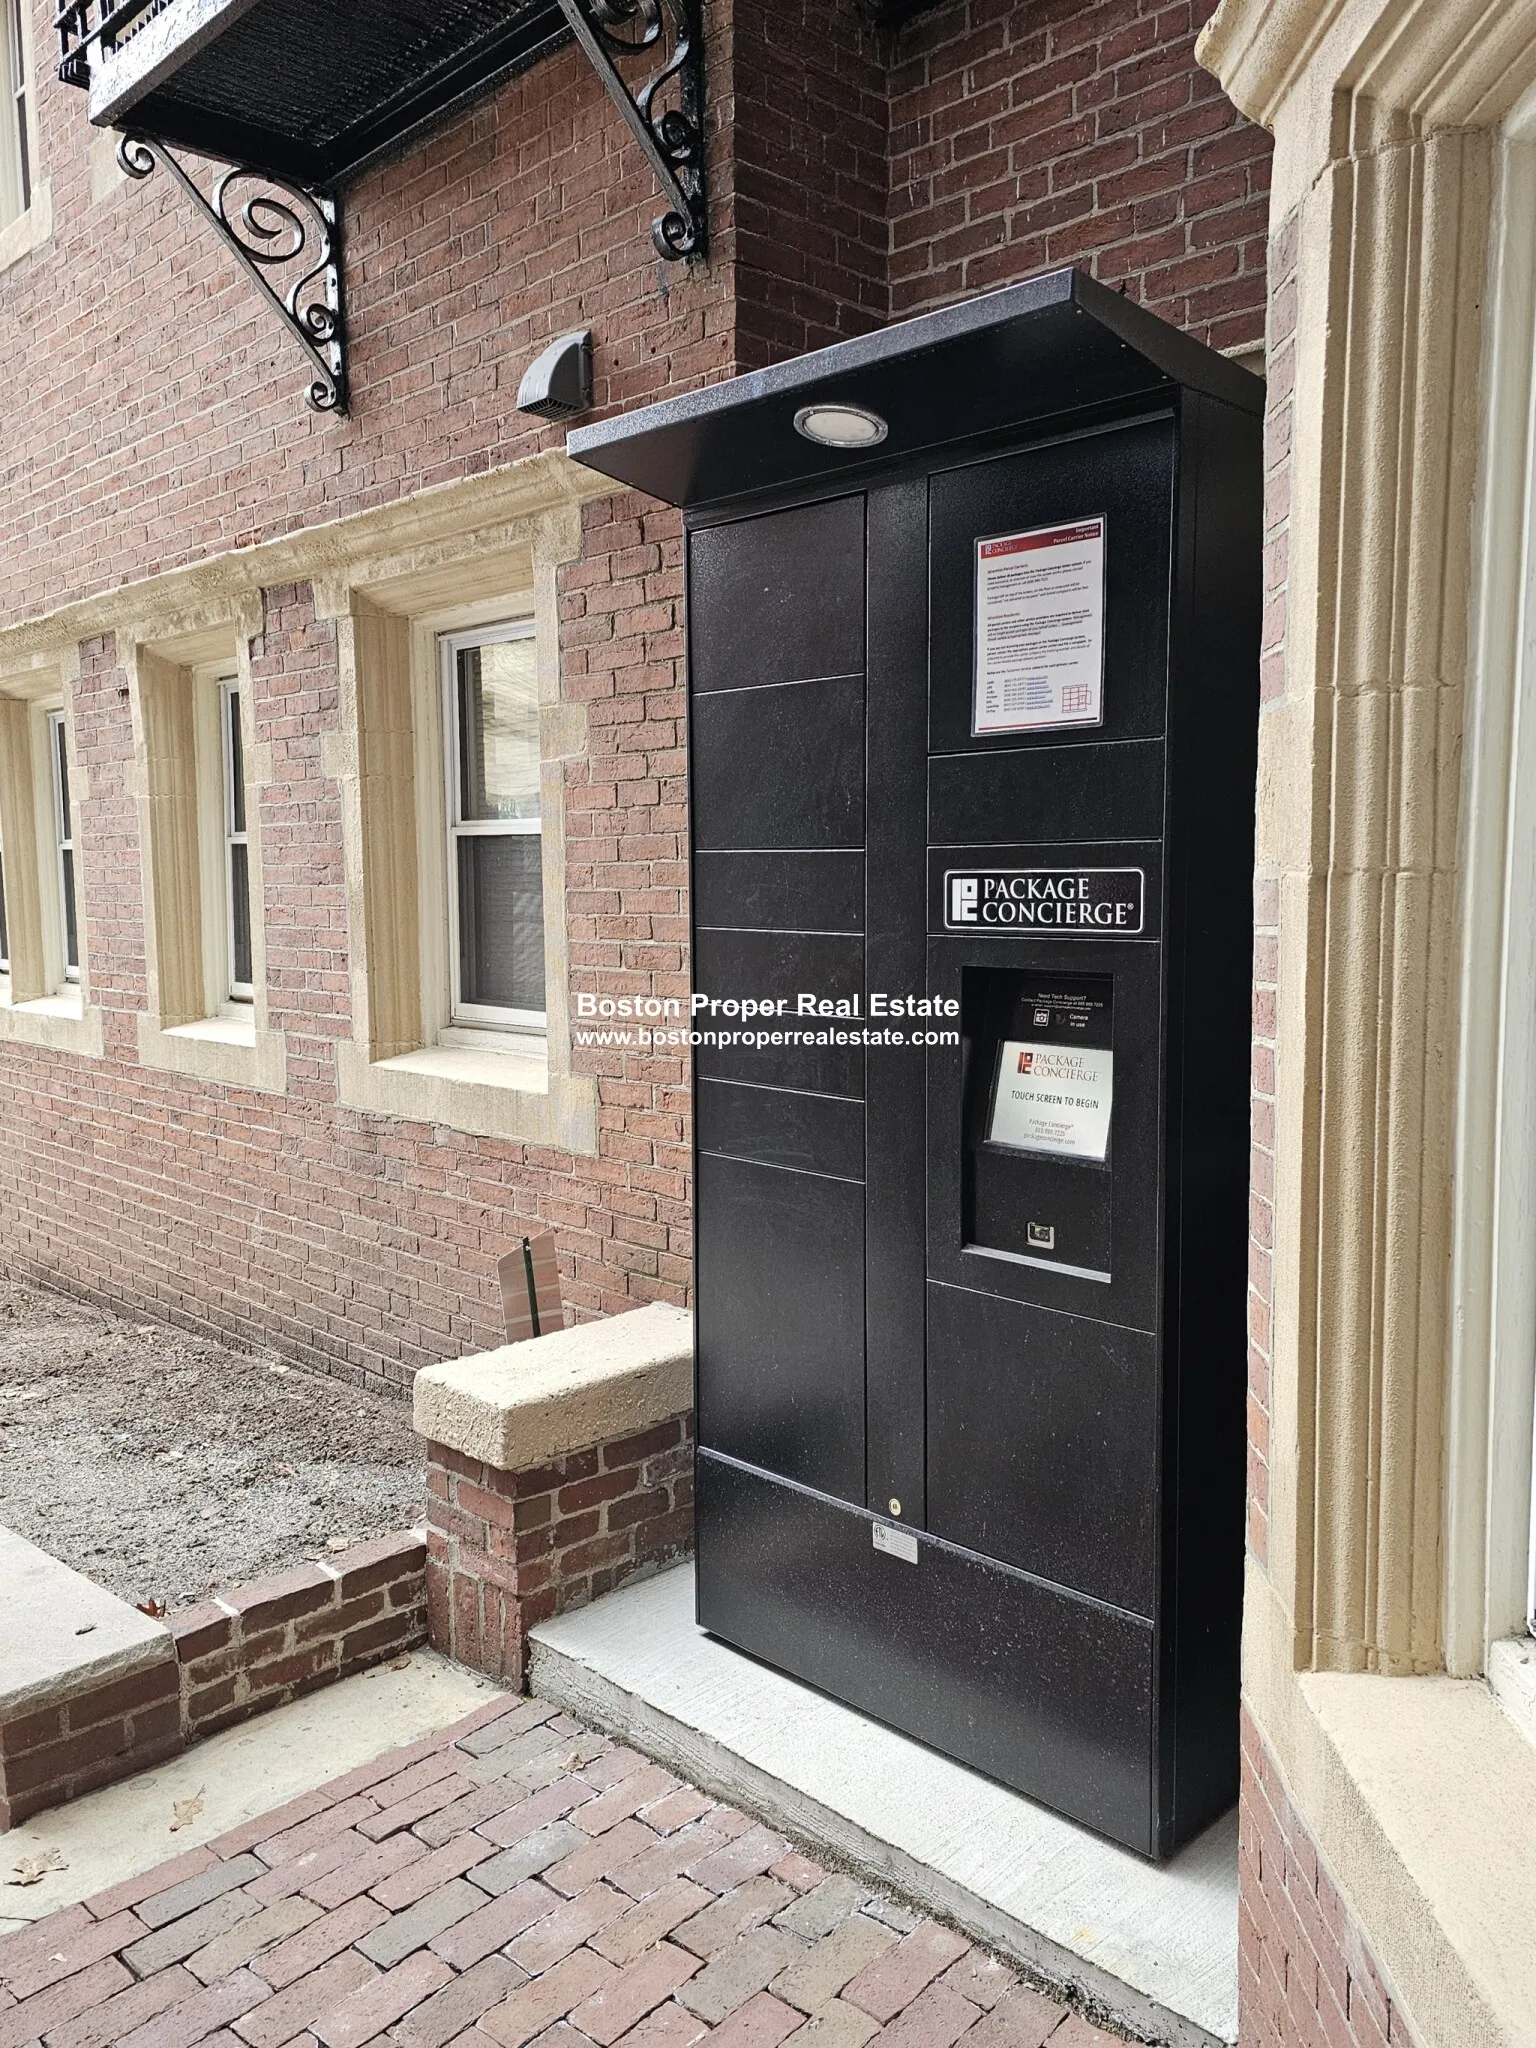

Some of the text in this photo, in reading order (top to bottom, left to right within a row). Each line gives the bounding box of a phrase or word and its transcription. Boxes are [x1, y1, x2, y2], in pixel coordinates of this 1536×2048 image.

[983, 878, 1090, 899] PACKAGE
[1069, 1013, 1089, 1021] Camera
[1035, 1053, 1086, 1068] PACKAGE
[1011, 1090, 1099, 1109] TOUCH SCREEN TO BEGIN
[1029, 1118, 1047, 1127] Package
